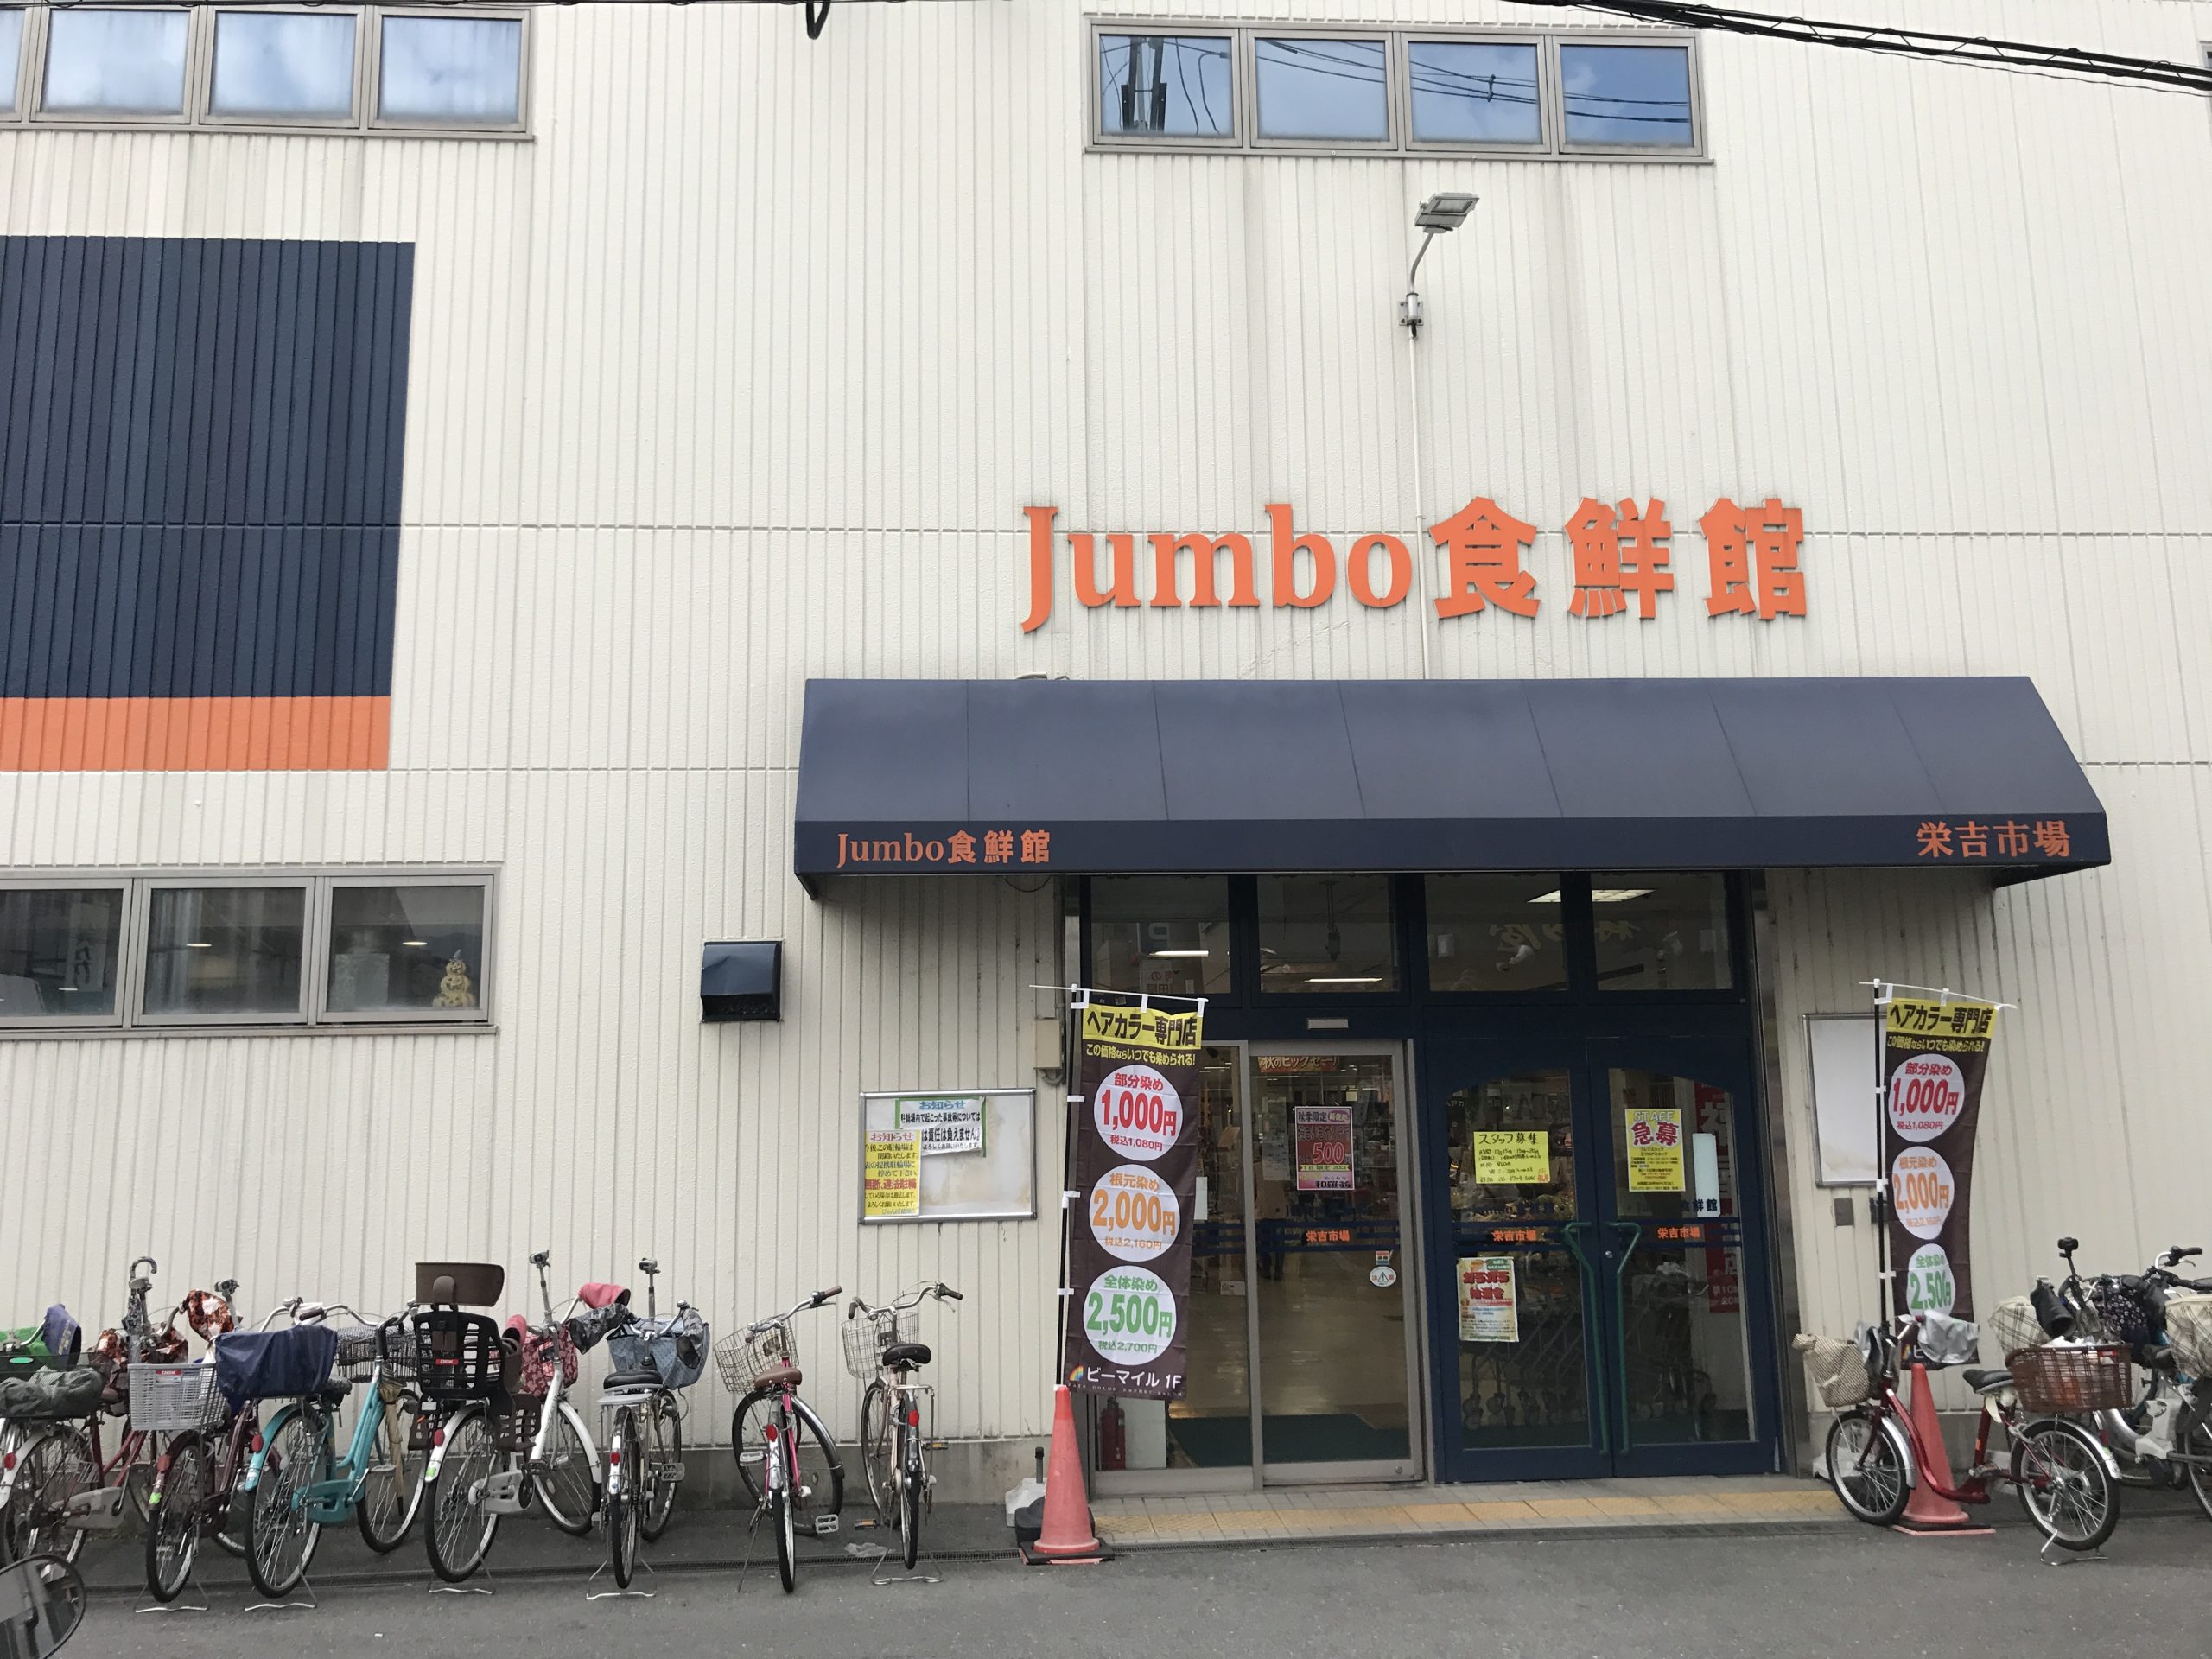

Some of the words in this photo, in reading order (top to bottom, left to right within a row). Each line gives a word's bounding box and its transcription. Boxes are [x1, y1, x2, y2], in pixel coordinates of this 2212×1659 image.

[1021, 496, 1807, 633] Jumbo食鮮館
[1916, 821, 2070, 858] 栄吉市場
[836, 830, 1051, 869] Jumbo食鮮館
[1087, 1010, 1198, 1046] ヘアカラー専門店
[1890, 1004, 1993, 1034] ヘアカラー専門店
[1905, 1062, 1953, 1076] 部分染め
[1114, 1072, 1164, 1091] 部分染め
[919, 1100, 967, 1110] お知らせ
[1893, 1077, 1959, 1116] 1,000円
[1102, 1089, 1177, 1136] 1,000円
[1634, 1111, 1674, 1122] STAFF
[870, 1132, 914, 1141] お知らせ
[1478, 1132, 1538, 1145] スタッフ募集
[1631, 1121, 1680, 1146] 急募
[1110, 1135, 1163, 1152] 税込1,080円
[1109, 1173, 1160, 1192] 根元染め
[1893, 1172, 1949, 1214] 2,000円
[1092, 1188, 1176, 1236] 2,000円
[1306, 1230, 1351, 1242] 栄吉市場
[1492, 1230, 1536, 1242] 栄吉市場
[1657, 1227, 1701, 1239] 栄吉市場
[1105, 1236, 1162, 1250] 税込2,160円
[1103, 1274, 1158, 1292] 全体染め
[1087, 1292, 1173, 1338] 2,500円
[1097, 1340, 1158, 1354] 税込2,700円
[1087, 1366, 1160, 1388] ビーマイル
[1165, 1374, 1182, 1389] 1F
